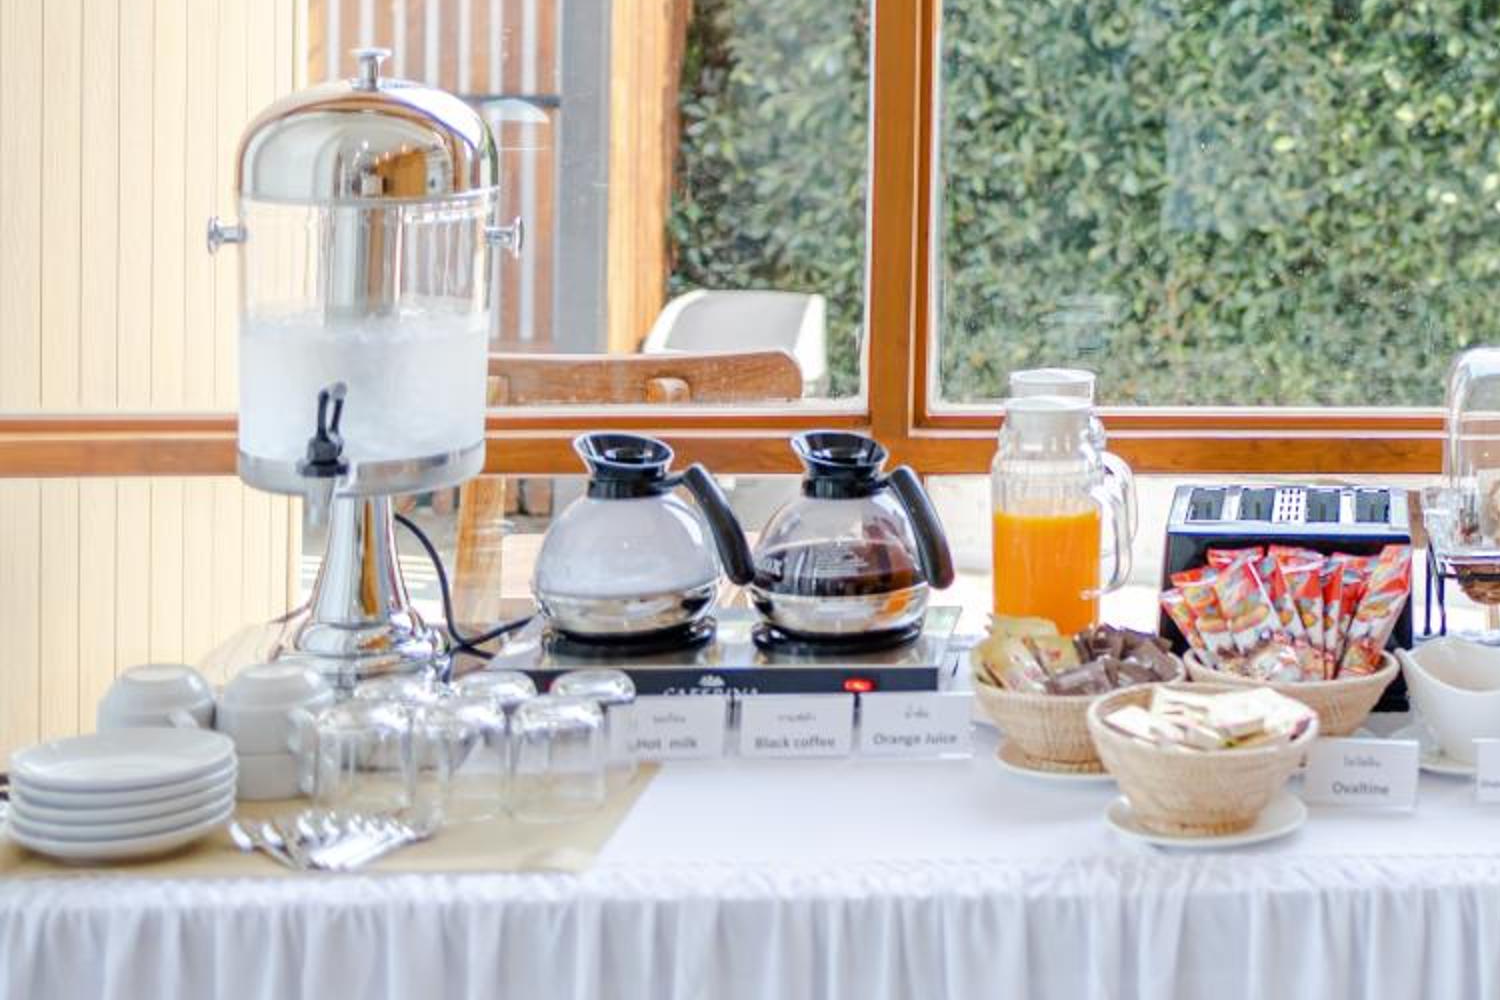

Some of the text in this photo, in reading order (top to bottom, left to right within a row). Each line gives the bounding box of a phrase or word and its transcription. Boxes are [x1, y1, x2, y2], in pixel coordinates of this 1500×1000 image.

[636, 735, 698, 749] Hot milk
[755, 735, 836, 748] Black coffee
[872, 730, 957, 747] Orange Juice
[1331, 780, 1390, 795] Ovaltine
